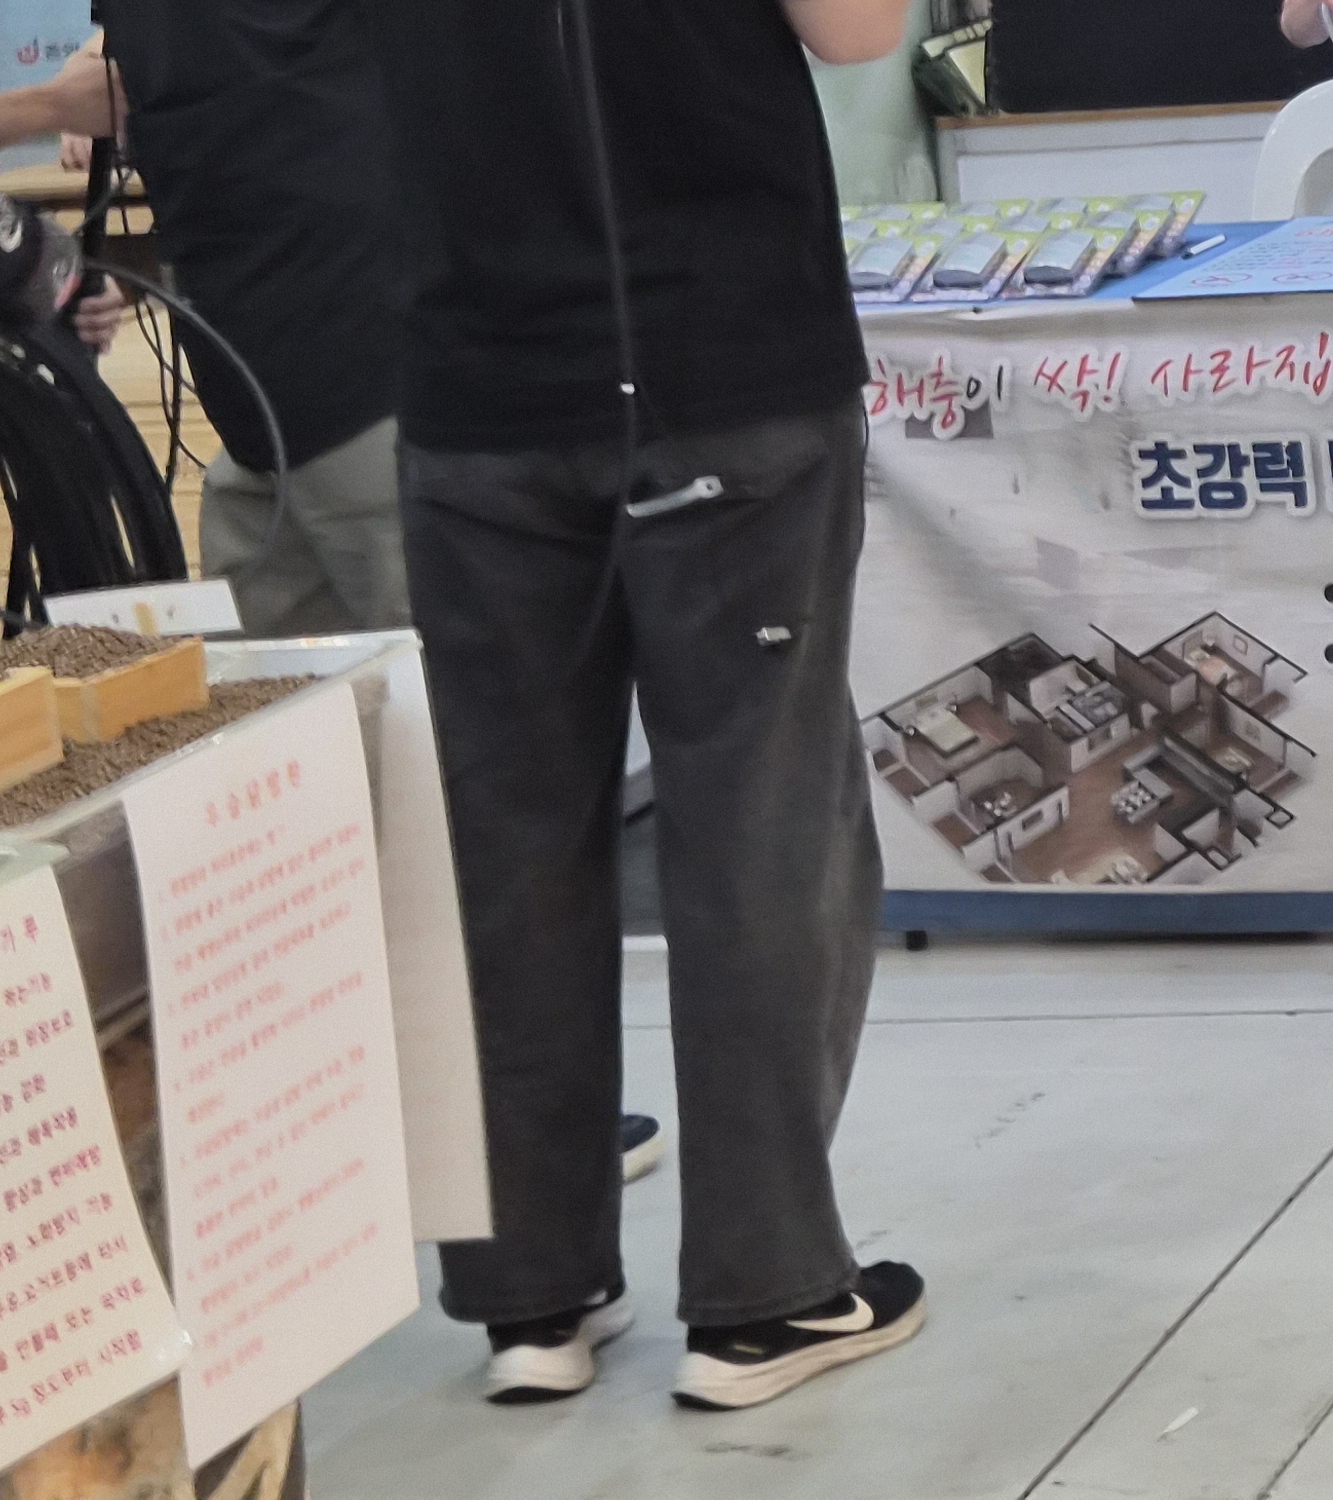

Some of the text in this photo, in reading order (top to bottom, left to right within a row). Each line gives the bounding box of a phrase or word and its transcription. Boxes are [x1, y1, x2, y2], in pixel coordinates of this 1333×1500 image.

[868, 358, 1004, 432] 해충이
[1034, 352, 1122, 412] 싹!
[1139, 438, 1306, 512] 초강력
